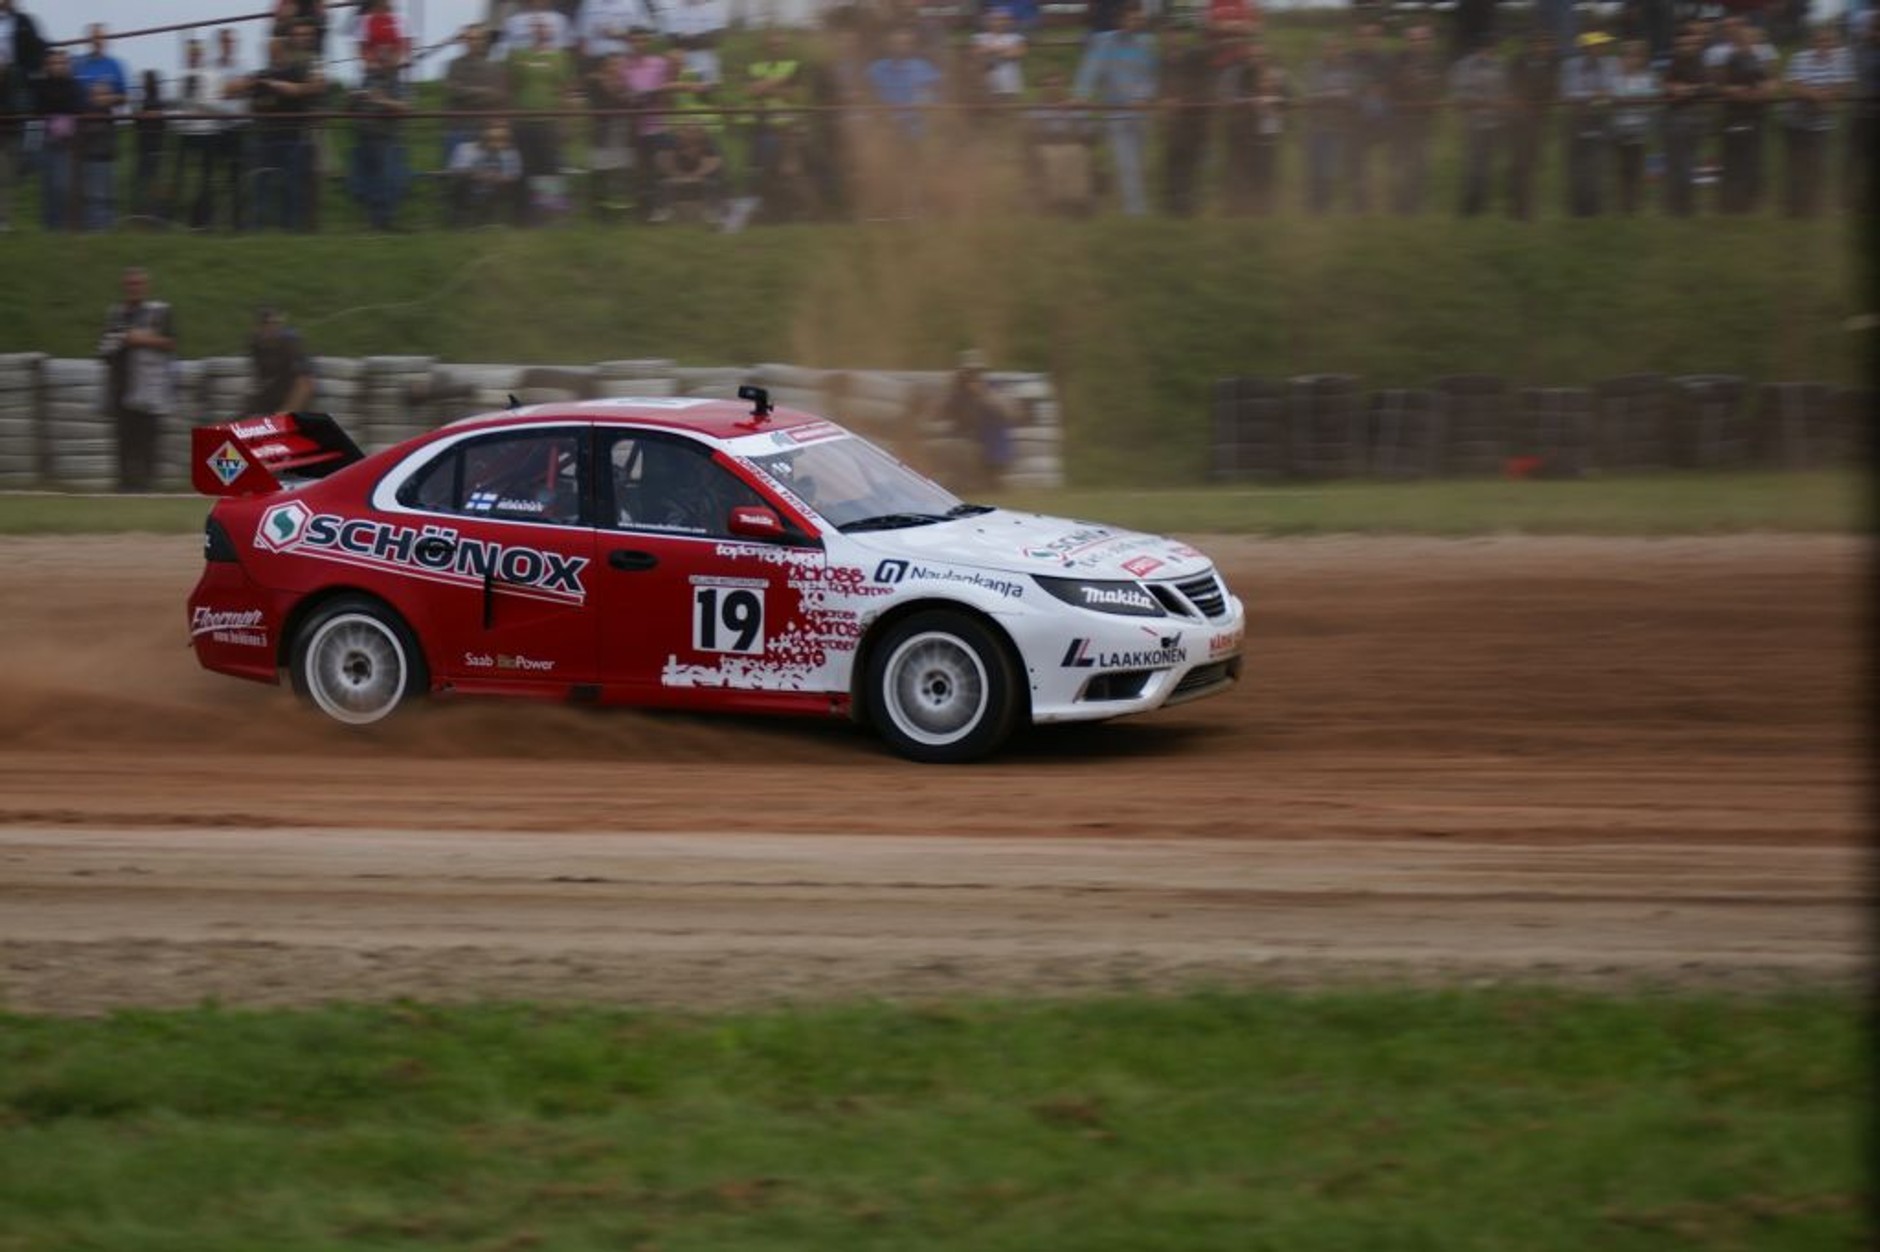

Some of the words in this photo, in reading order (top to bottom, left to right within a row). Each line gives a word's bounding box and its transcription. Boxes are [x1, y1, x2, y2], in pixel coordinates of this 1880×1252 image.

[305, 513, 589, 595] SCHÖNOX
[697, 588, 762, 651] 19
[465, 652, 494, 667] Saab
[1100, 649, 1187, 668] LAAKKONEN
